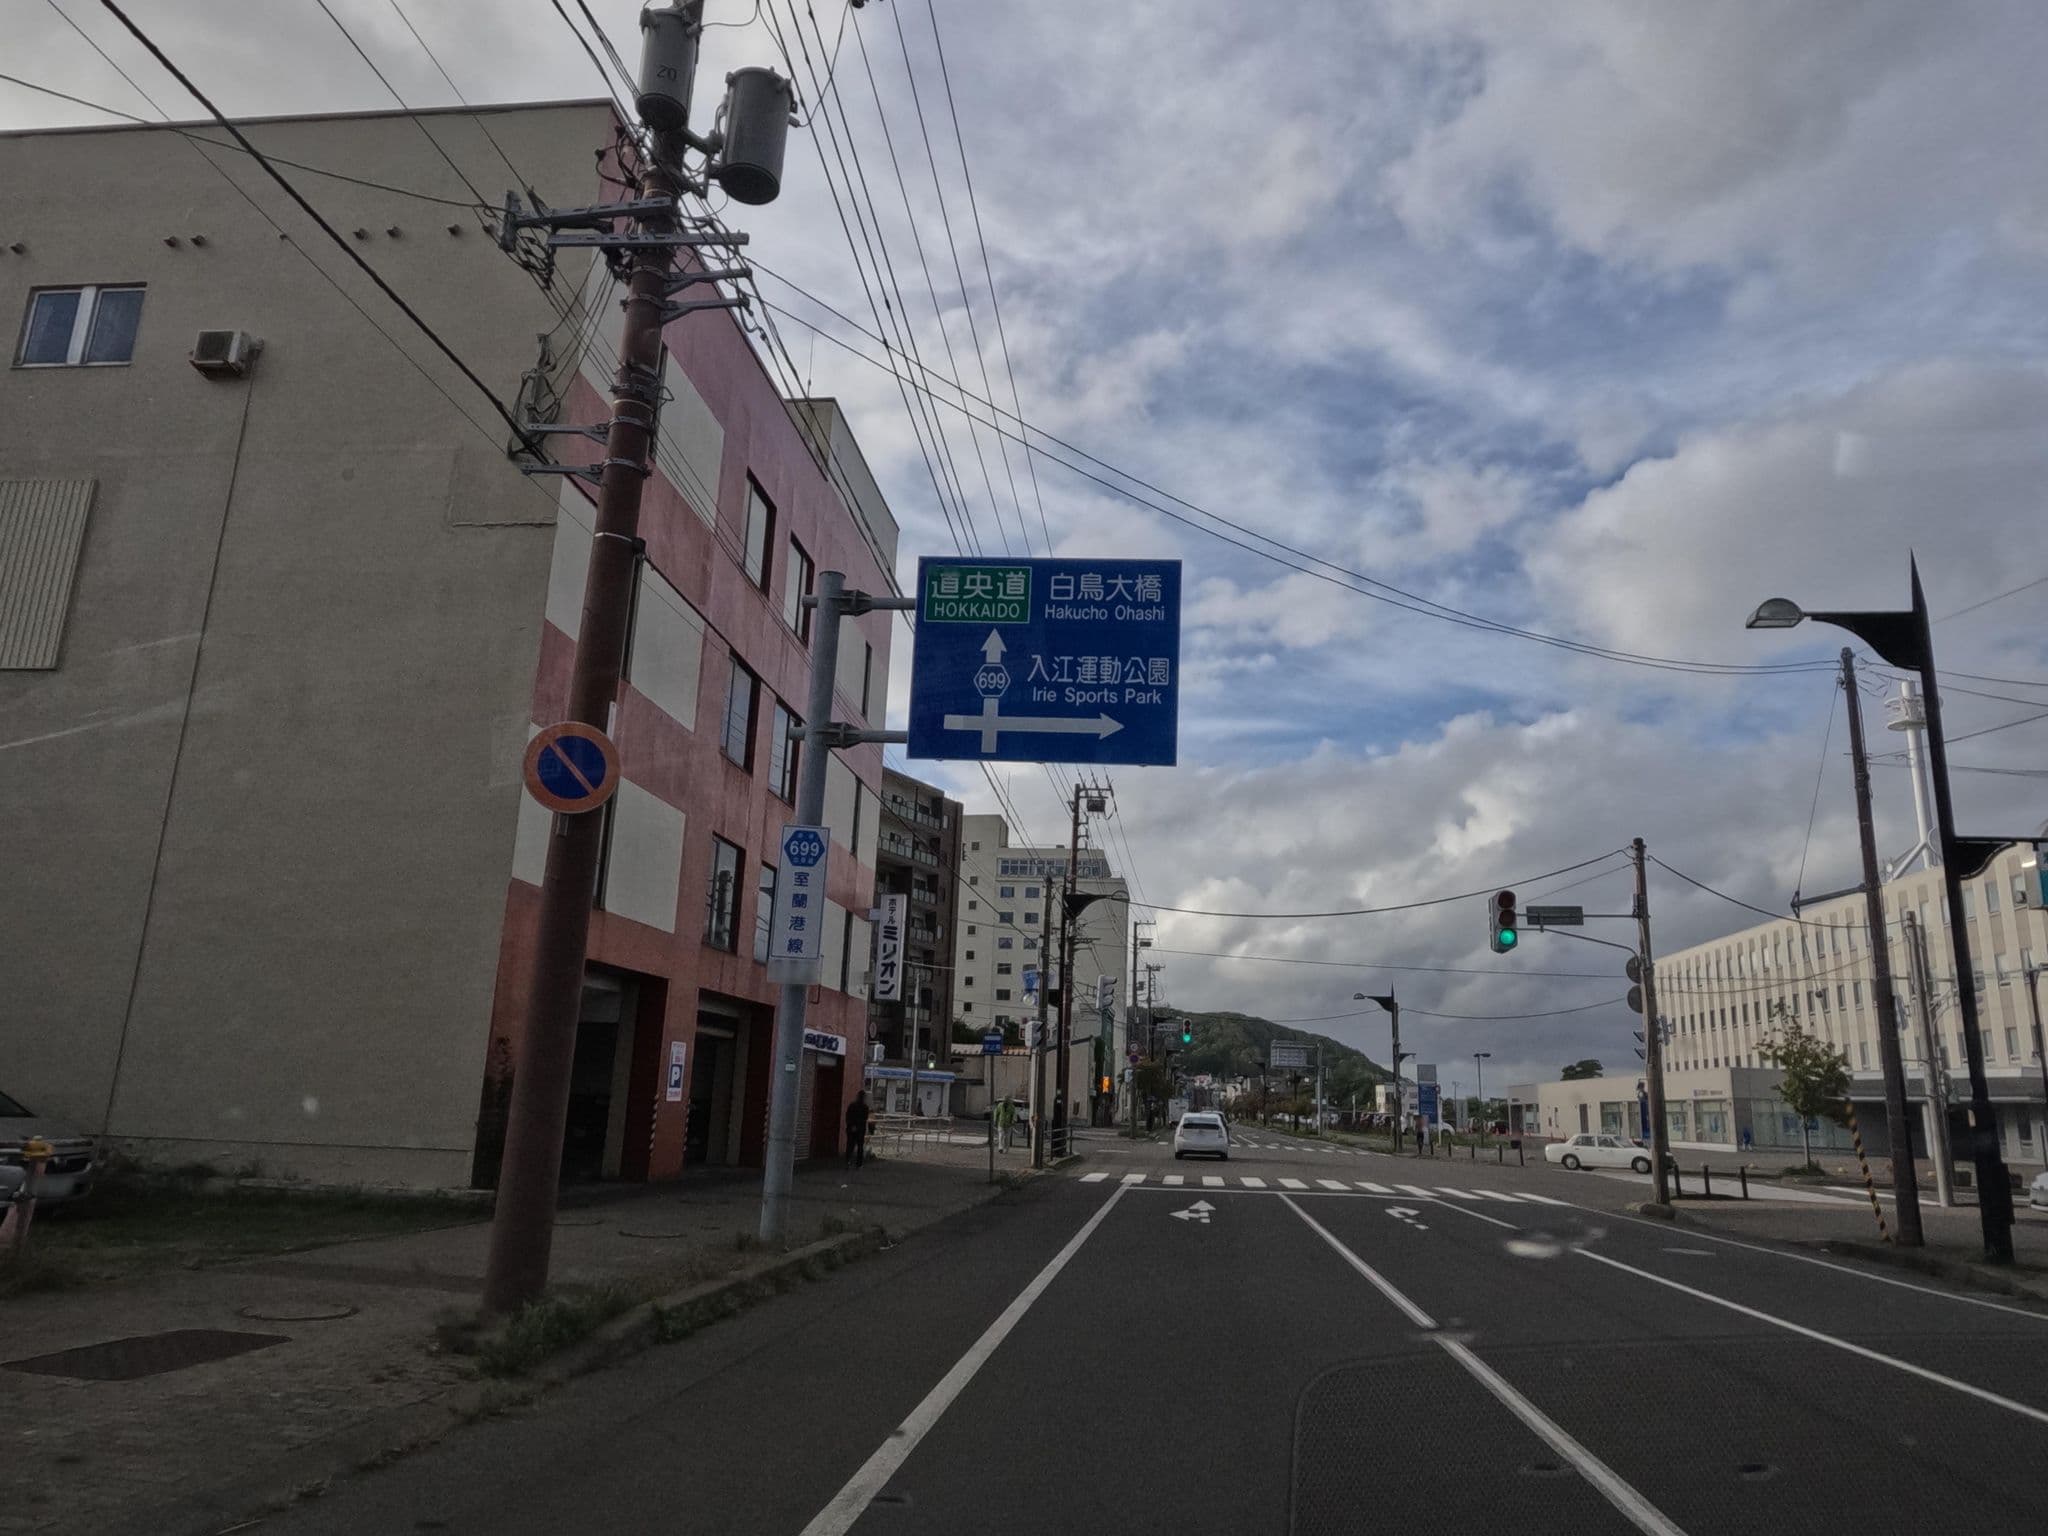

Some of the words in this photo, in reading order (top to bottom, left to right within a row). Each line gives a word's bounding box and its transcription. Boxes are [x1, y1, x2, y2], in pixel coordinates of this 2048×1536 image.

[931, 572, 1026, 601] 道央道
[1050, 573, 1163, 603] 白鳥大橋
[934, 602, 1020, 618] HOKKAIDO
[1045, 604, 1108, 621] Hakucho
[1114, 605, 1165, 621] Ohashi
[1027, 654, 1170, 686] 入江運動公園
[978, 671, 1006, 690] 699
[1032, 686, 1057, 702] Irie
[1064, 687, 1118, 706] Sports
[1125, 688, 1162, 704] Park
[790, 840, 819, 857] 699
[786, 871, 810, 954] 室蘭港線
[670, 1065, 681, 1086] P
